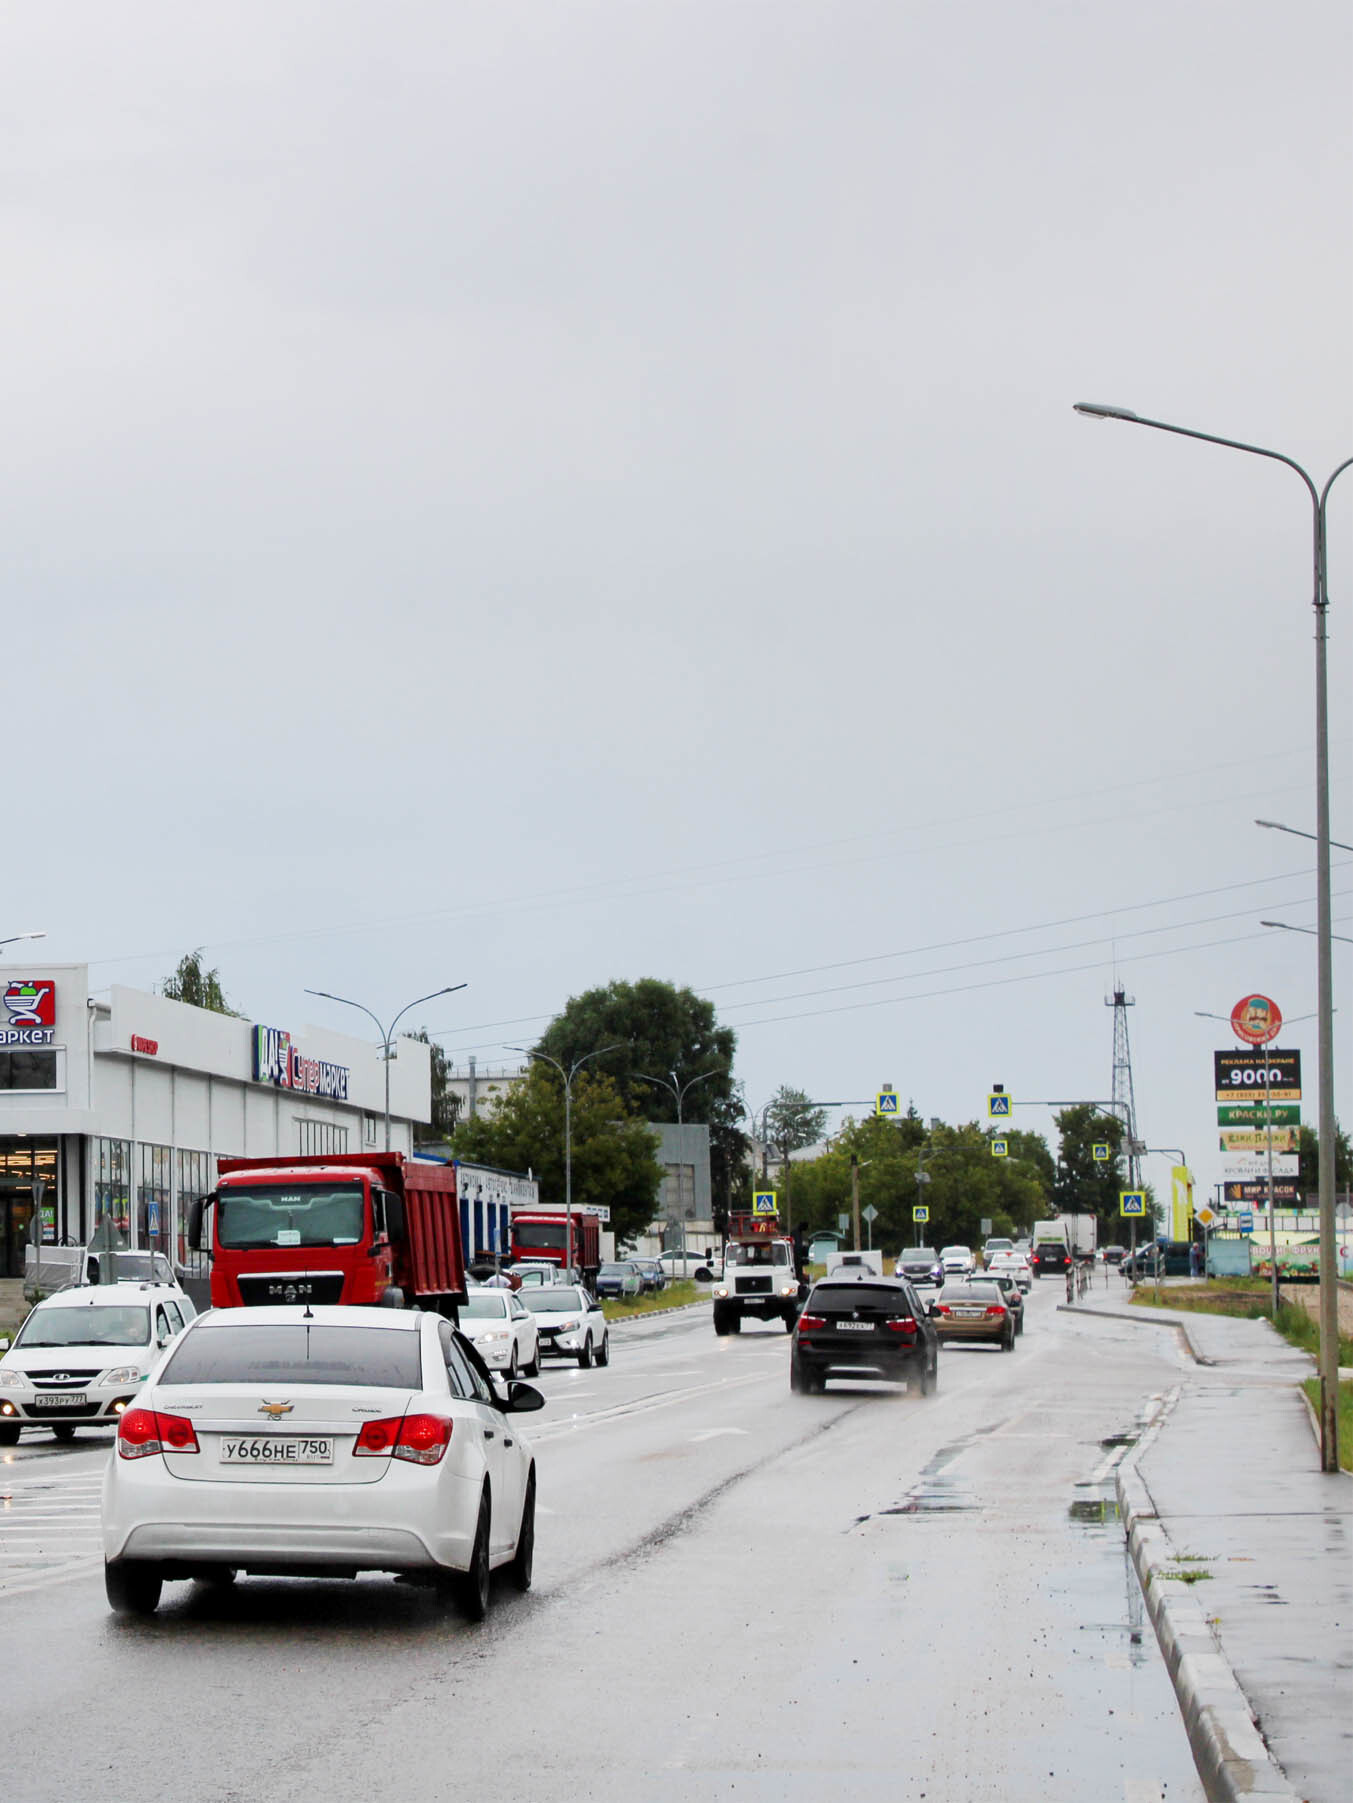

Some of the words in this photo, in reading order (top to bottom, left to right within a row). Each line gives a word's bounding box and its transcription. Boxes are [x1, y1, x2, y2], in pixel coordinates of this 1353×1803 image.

[259, 1026, 279, 1080] ДА!
[1244, 1185, 1261, 1193] МИР
[1264, 1185, 1295, 1193] КАСОК
[268, 1284, 313, 1295] MAN
